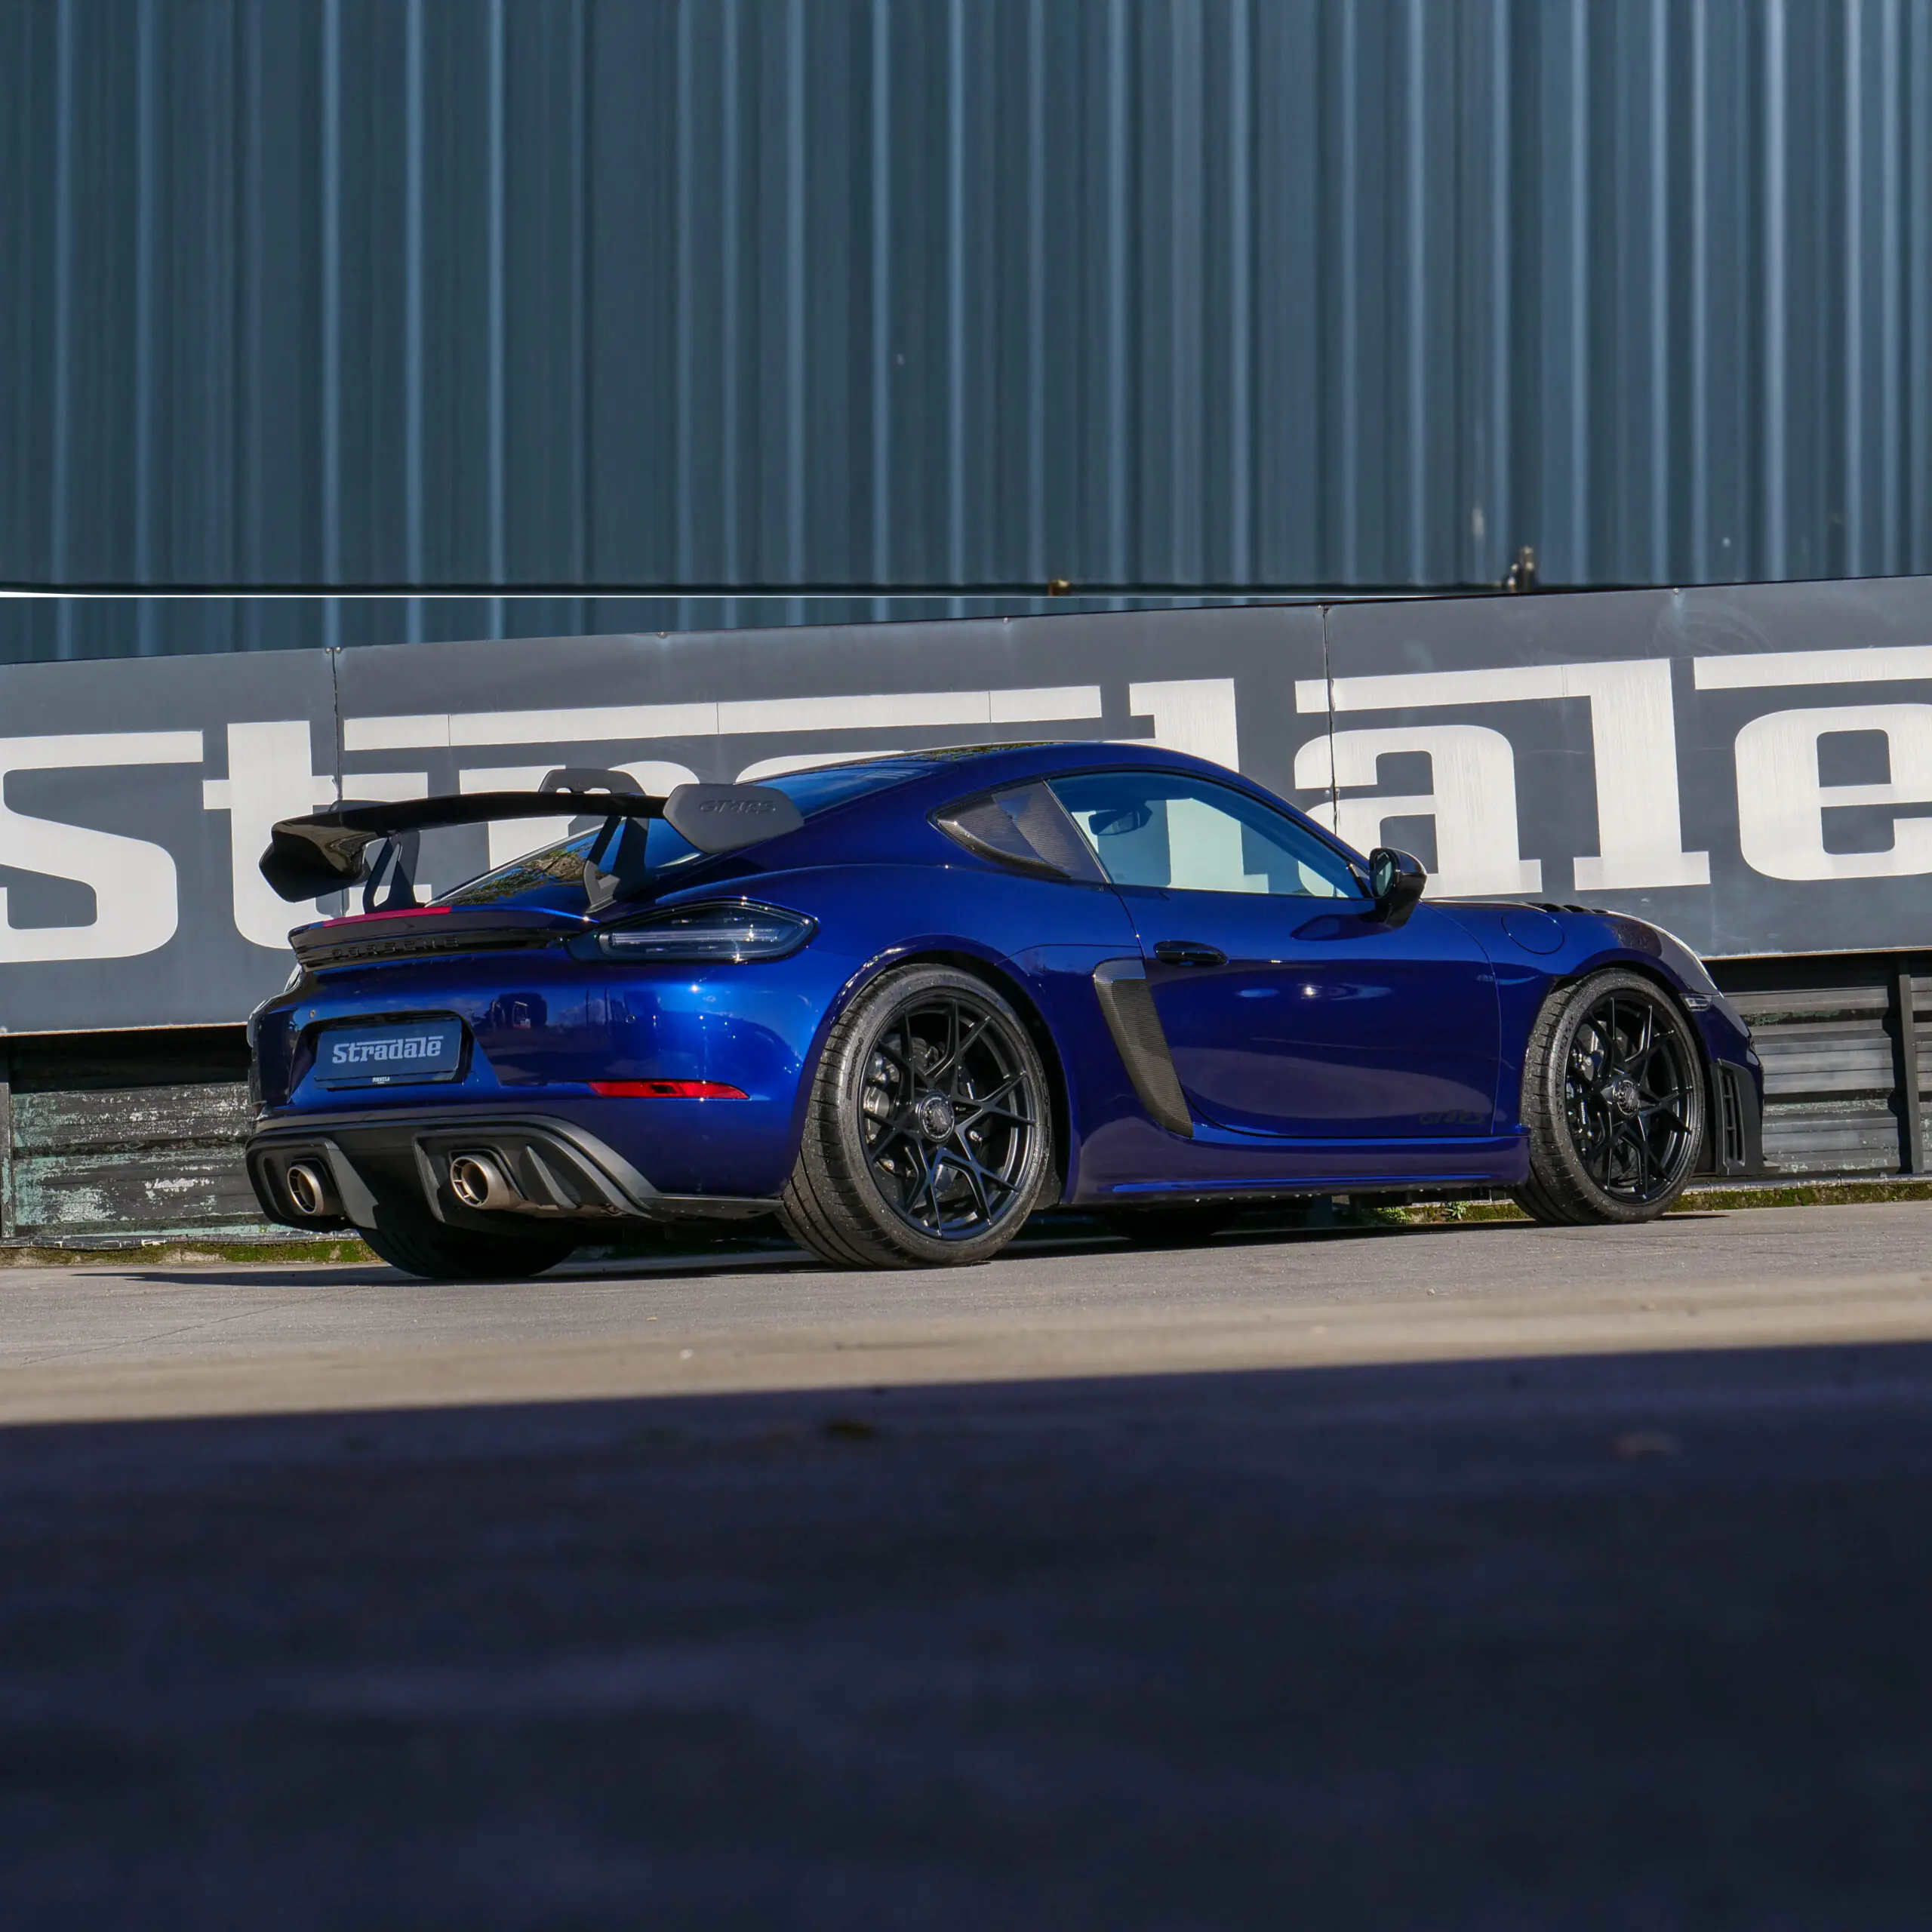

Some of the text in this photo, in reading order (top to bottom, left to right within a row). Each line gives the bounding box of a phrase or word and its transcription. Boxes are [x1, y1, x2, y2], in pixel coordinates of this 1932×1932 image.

[0, 645, 1932, 962] Stdale
[331, 937, 459, 960] PORSCHE
[332, 1036, 444, 1063] Stradale
